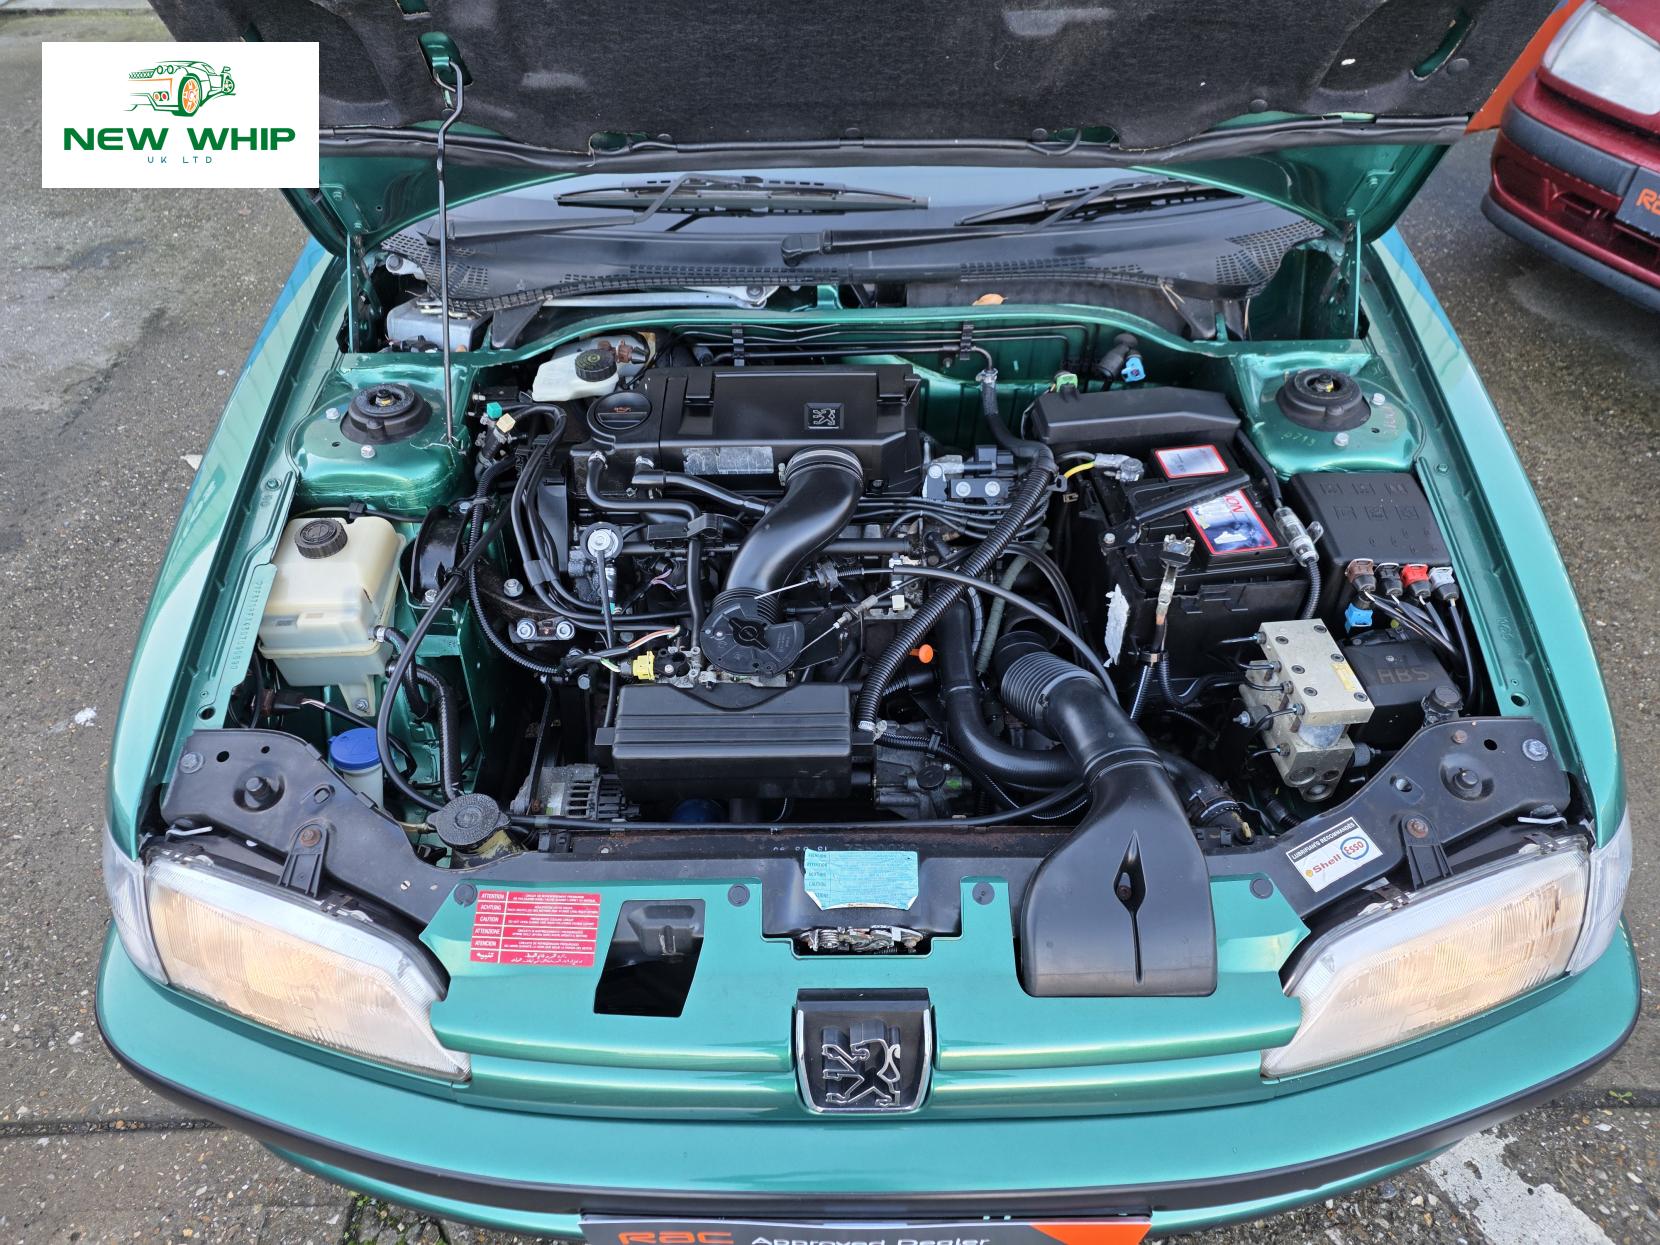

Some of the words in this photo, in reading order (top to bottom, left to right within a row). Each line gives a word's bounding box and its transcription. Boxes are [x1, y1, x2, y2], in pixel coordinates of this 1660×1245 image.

[1377, 666, 1429, 684] ABS
[1312, 854, 1342, 873] Shell
[752, 1236, 885, 1245] Approved
